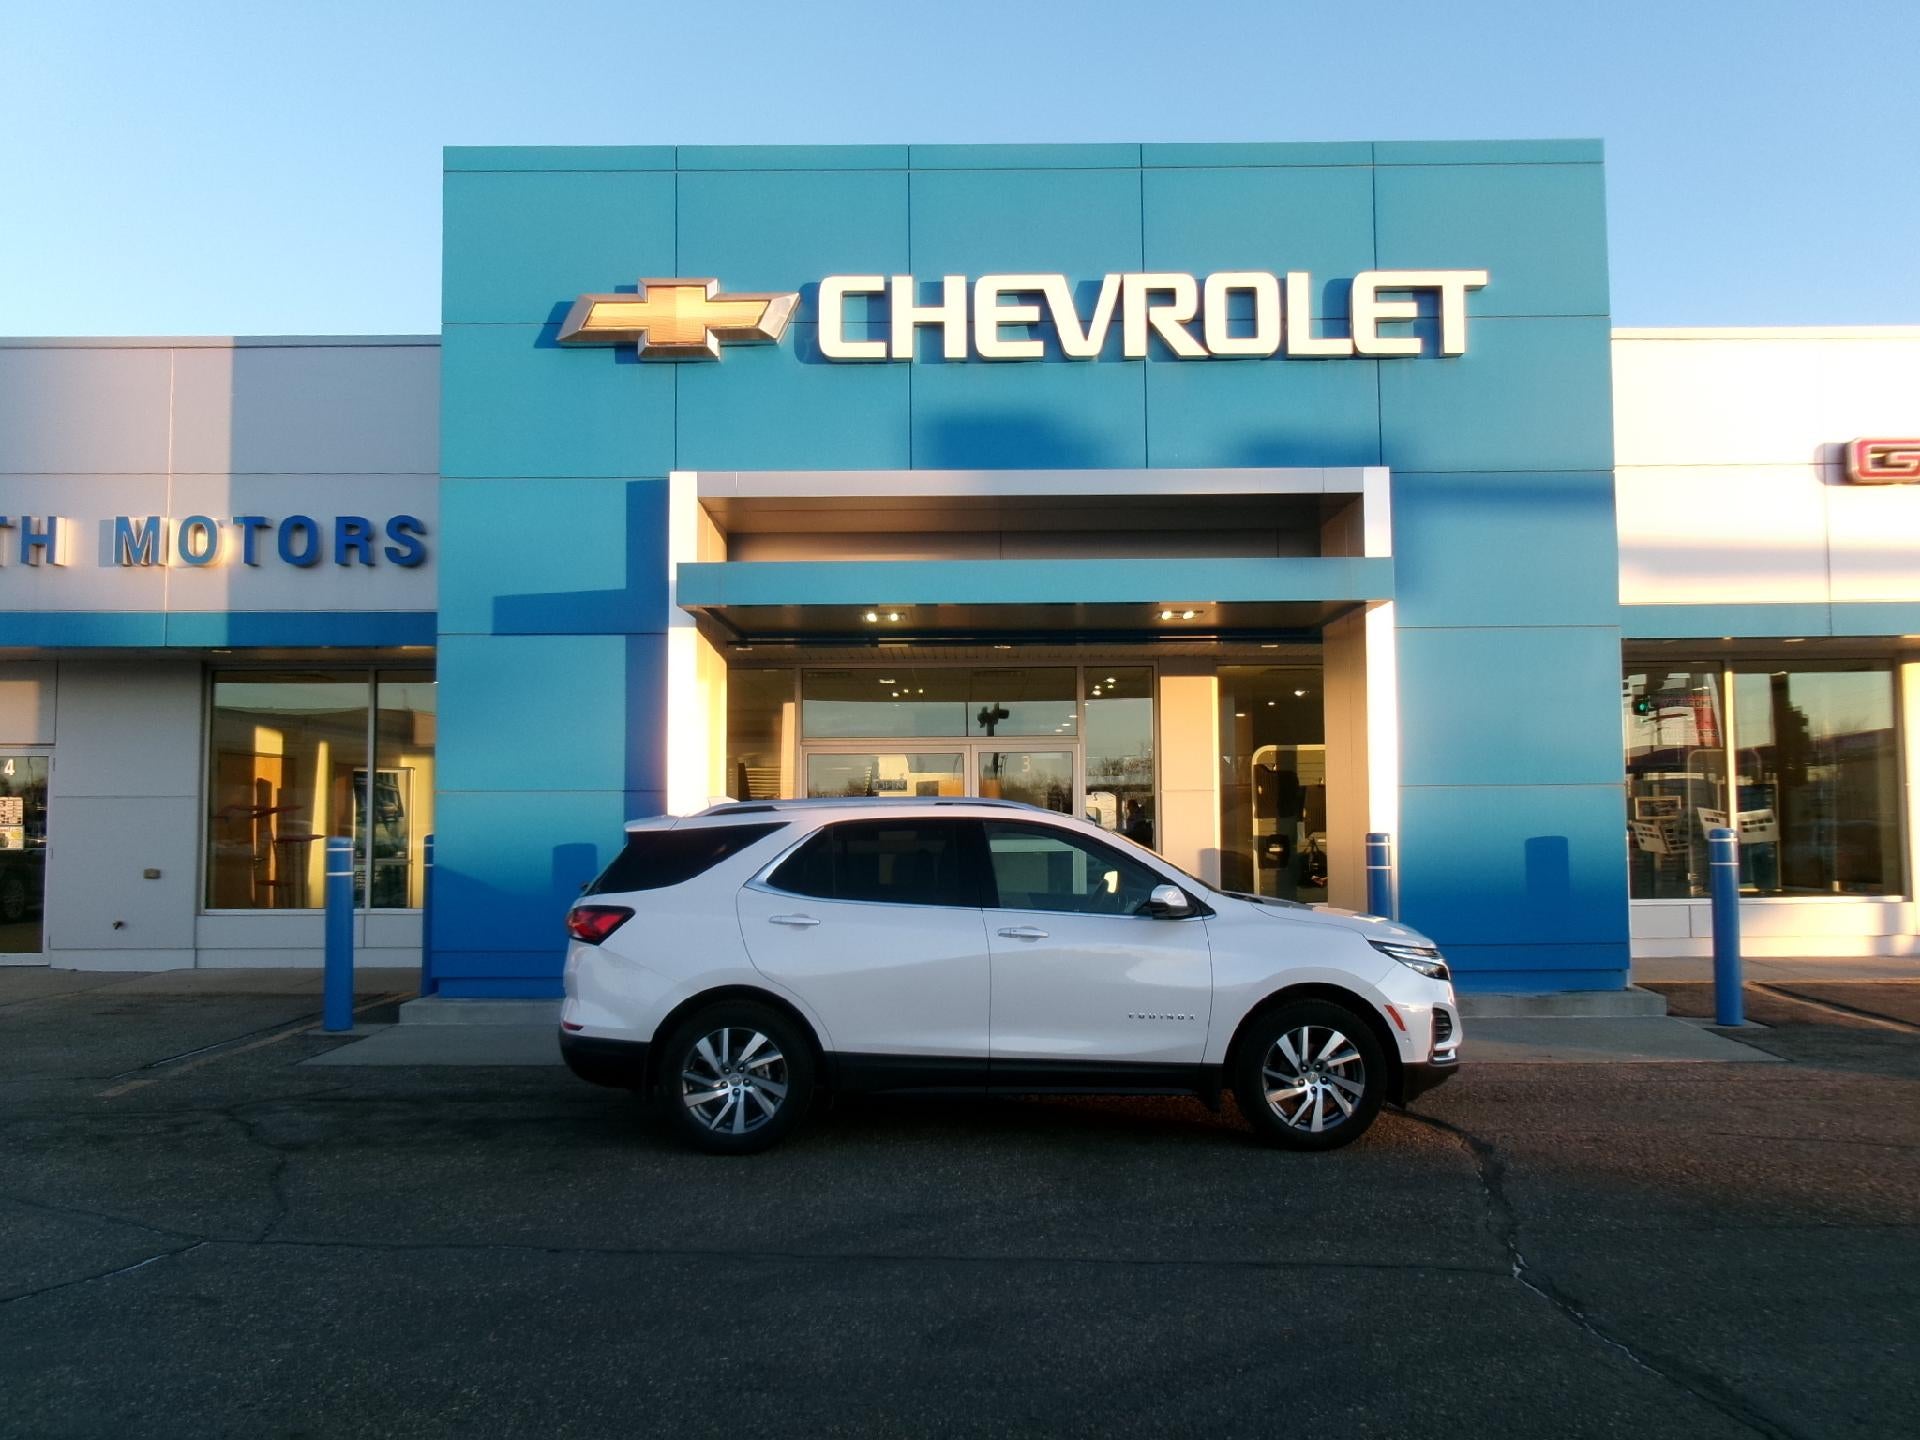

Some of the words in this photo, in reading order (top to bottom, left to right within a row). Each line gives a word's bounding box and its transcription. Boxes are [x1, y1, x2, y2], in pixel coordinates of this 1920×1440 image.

[817, 270, 1489, 361] CHEVROLET
[113, 514, 428, 567] MOTORS
[3, 758, 16, 776] 4
[1021, 755, 1031, 773] 3
